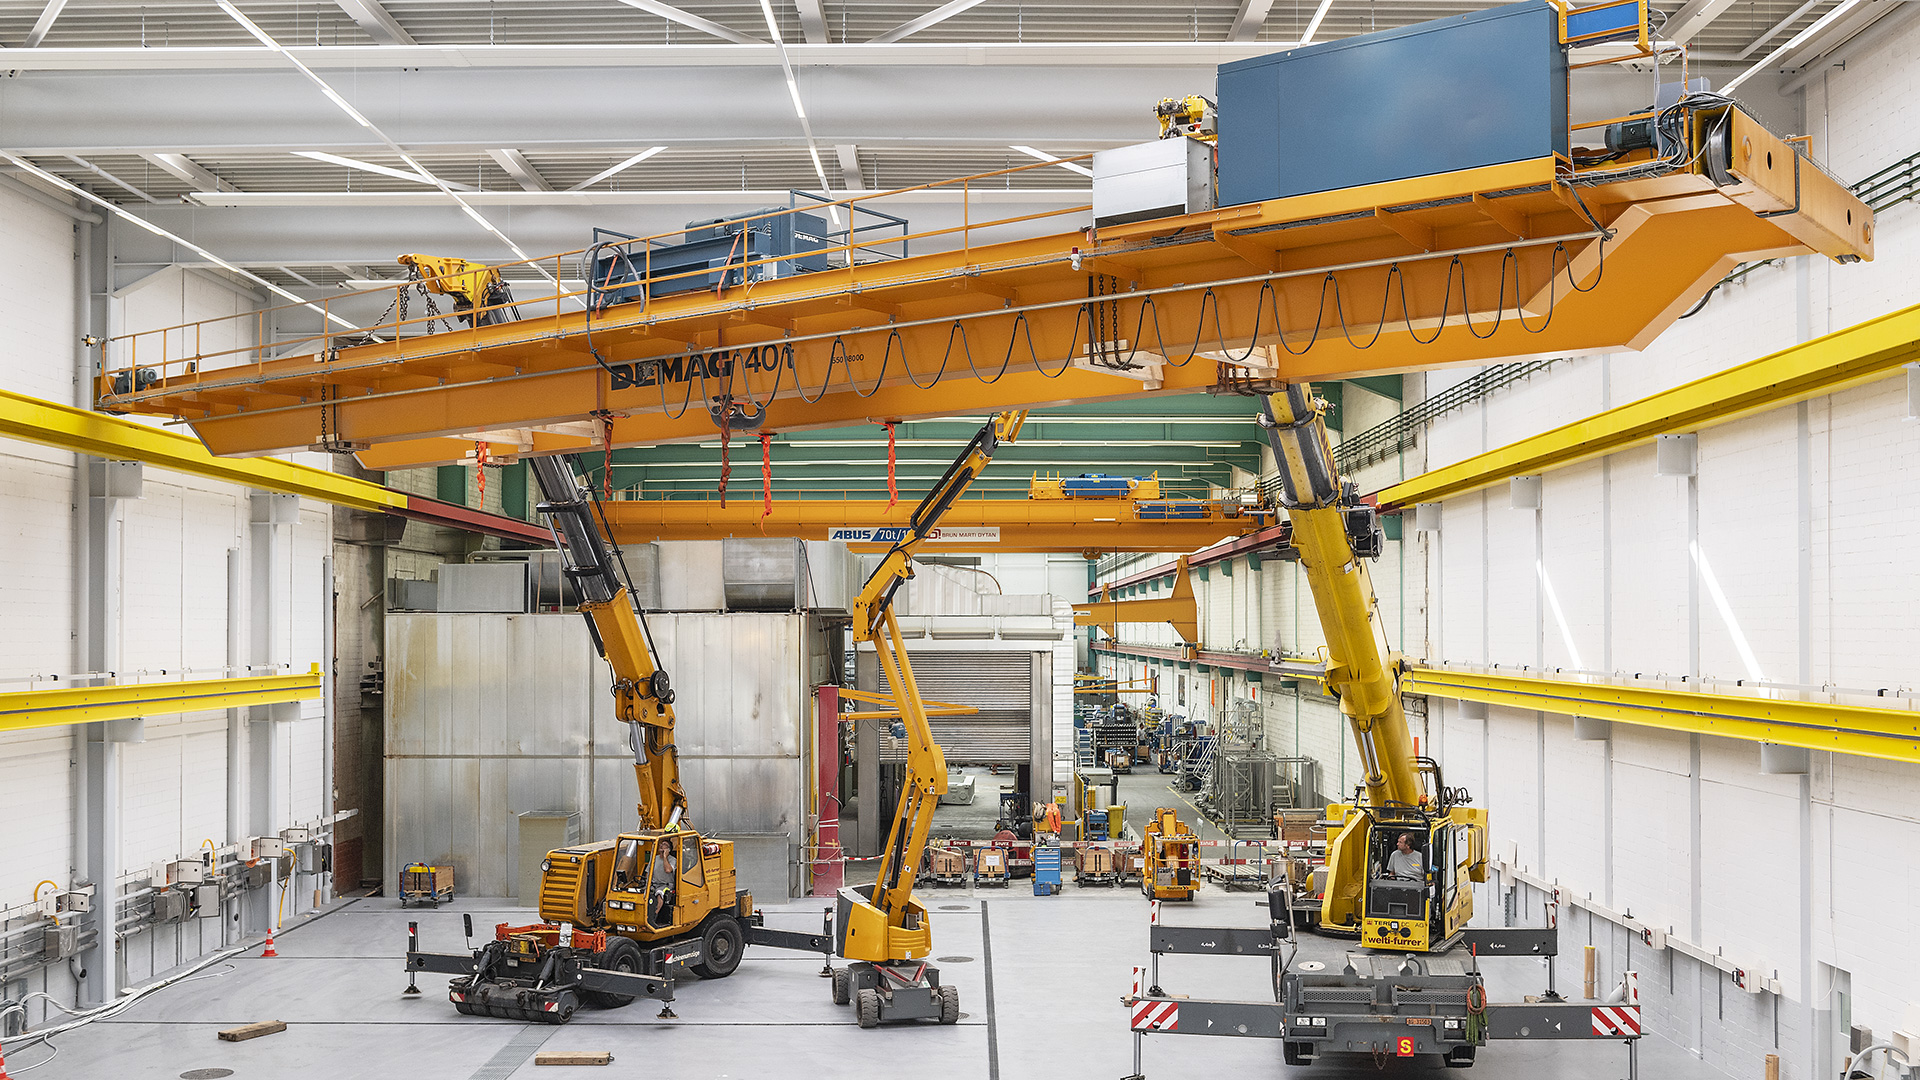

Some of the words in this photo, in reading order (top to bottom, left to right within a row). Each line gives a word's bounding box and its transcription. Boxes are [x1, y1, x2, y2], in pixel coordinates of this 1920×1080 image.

[611, 351, 734, 391] DEMAG
[744, 344, 779, 373] 40
[832, 530, 871, 540] ABUS
[1368, 936, 1422, 946] welti-furrer
[1400, 1039, 1412, 1054] S
